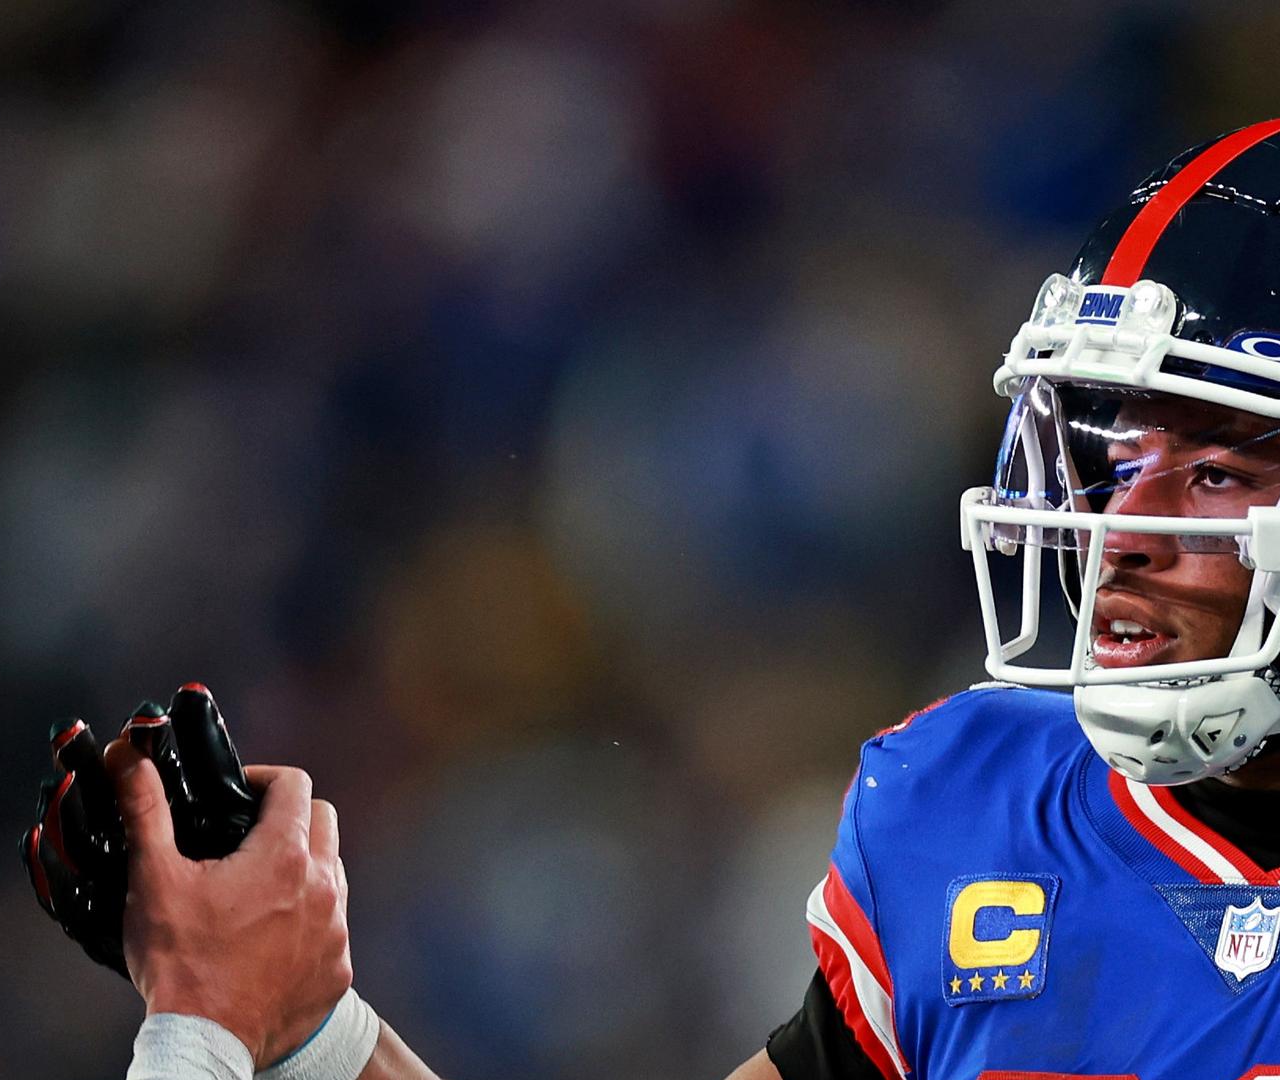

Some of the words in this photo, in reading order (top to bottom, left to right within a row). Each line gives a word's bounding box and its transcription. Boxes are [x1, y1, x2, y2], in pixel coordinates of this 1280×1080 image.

[1078, 292, 1126, 319] GIANT
[949, 880, 1045, 969] C
[1226, 934, 1264, 964] NFL
